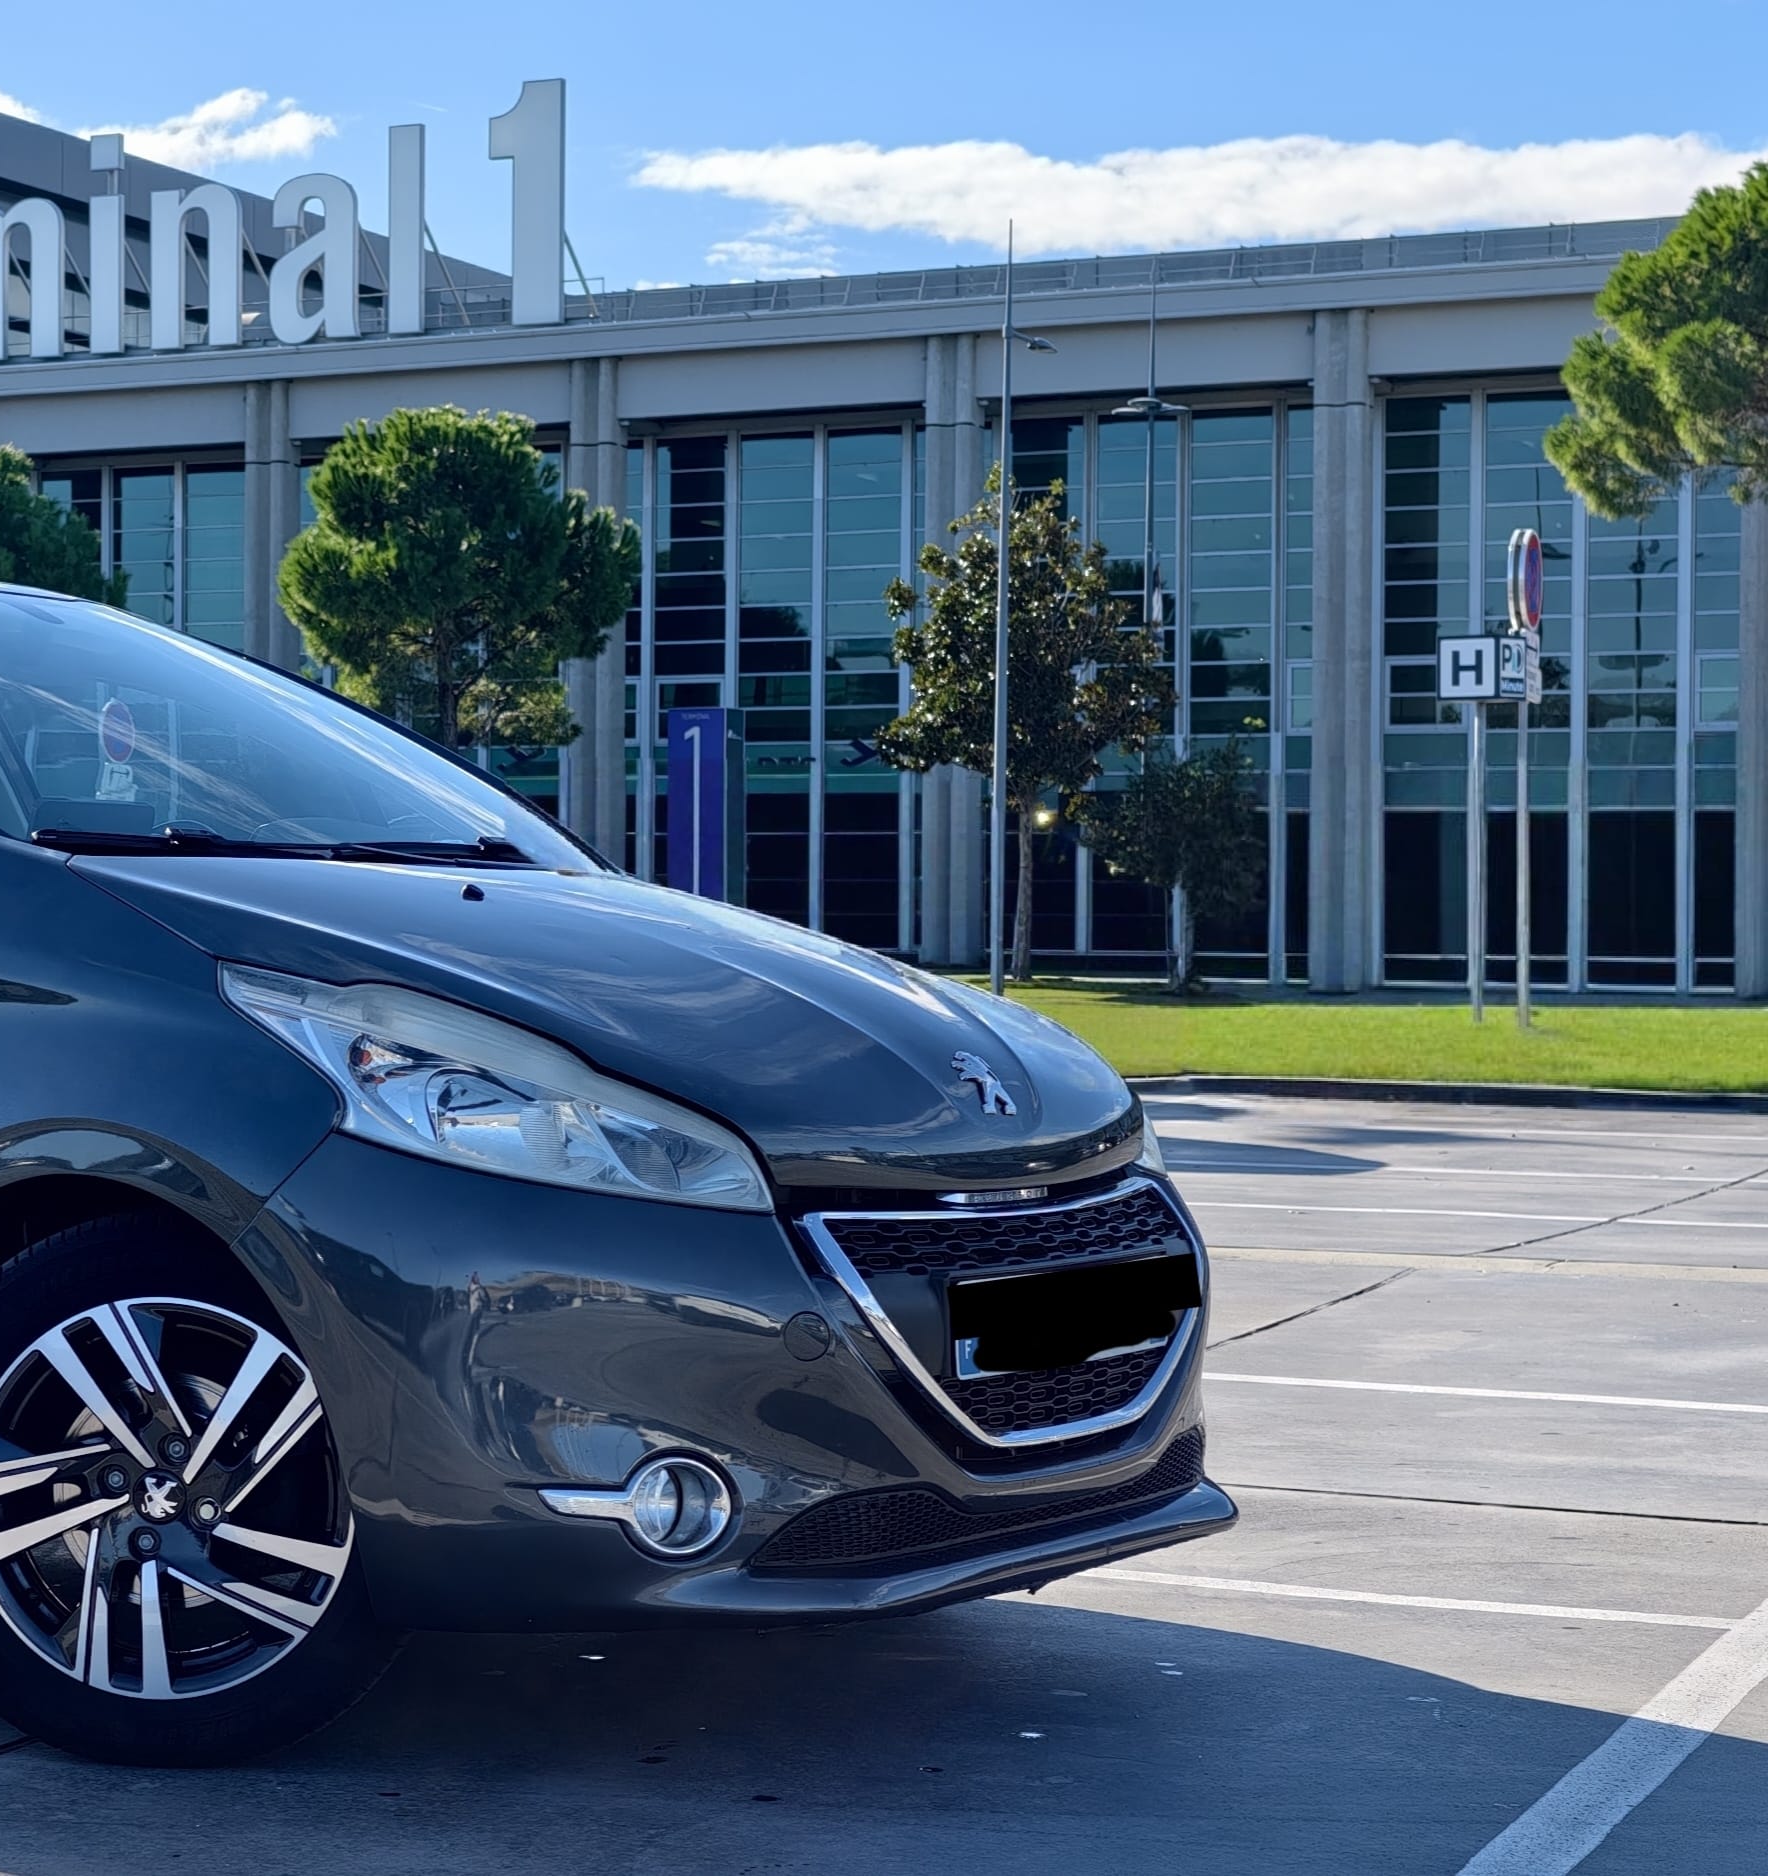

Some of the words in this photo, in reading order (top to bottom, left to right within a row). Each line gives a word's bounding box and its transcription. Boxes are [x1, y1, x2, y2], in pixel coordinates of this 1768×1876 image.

[488, 78, 566, 327] 1
[1452, 650, 1484, 687] H
[684, 726, 701, 896] 1
[965, 1339, 972, 1359] F
